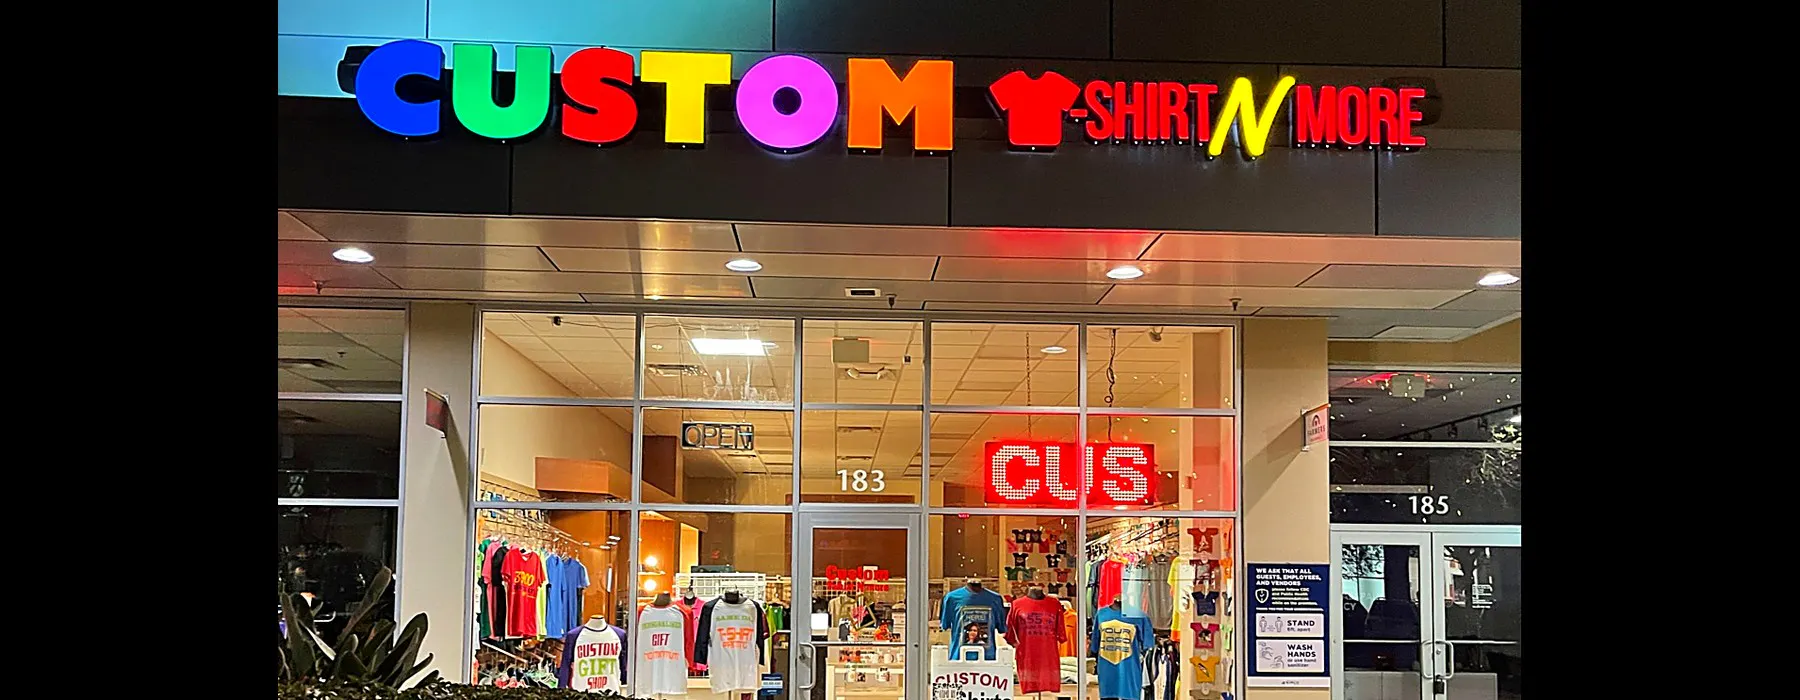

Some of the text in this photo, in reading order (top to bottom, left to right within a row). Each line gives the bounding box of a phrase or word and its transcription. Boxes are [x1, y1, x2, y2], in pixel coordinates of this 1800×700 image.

[355, 39, 954, 150] CUSTOM
[1208, 76, 1296, 157] N
[1296, 85, 1427, 146] MORE
[684, 424, 753, 449] OPEN
[837, 469, 885, 492] 183
[991, 445, 1147, 501] CUS
[1408, 495, 1449, 515] 185
[577, 642, 619, 658] CUSTOM
[651, 633, 670, 647] GIFT
[579, 658, 617, 677] GIFT
[587, 676, 608, 689] SHOP
